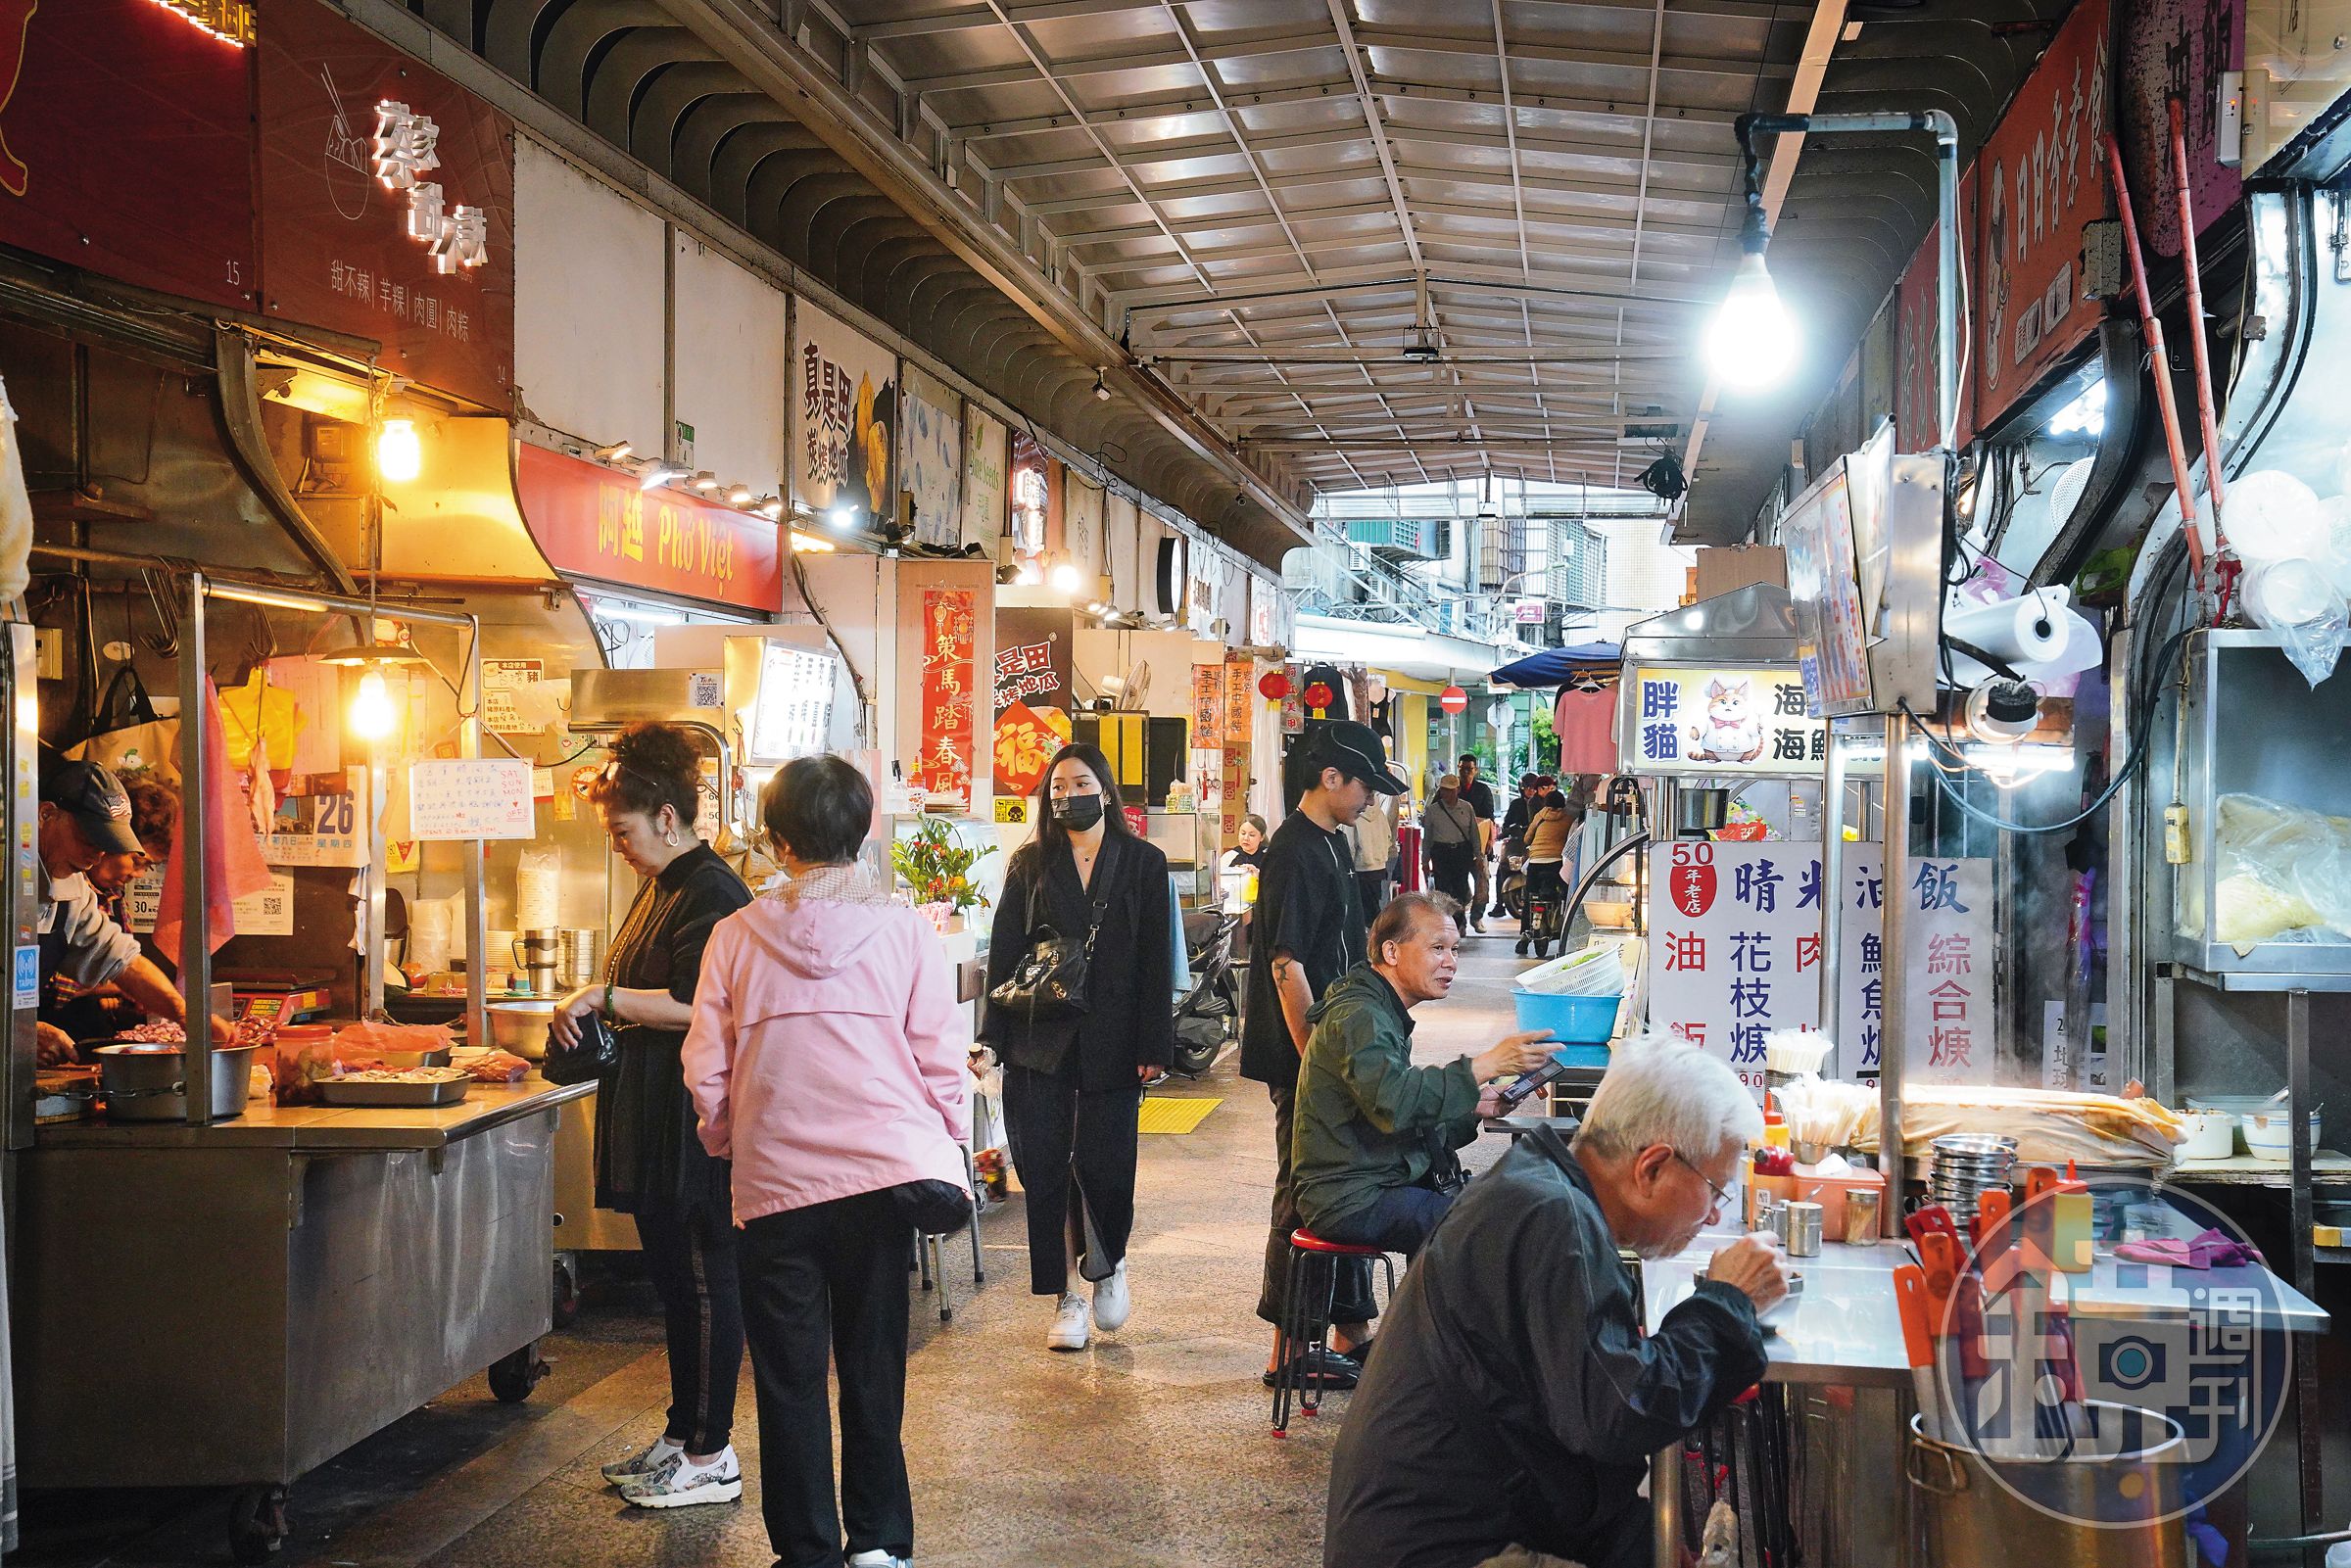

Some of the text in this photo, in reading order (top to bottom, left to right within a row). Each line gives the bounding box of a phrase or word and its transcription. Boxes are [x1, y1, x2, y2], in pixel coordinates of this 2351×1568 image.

[2016, 24, 2106, 263] 日日香素食
[226, 260, 240, 286] 15
[331, 260, 370, 305] 甜不辣
[379, 278, 406, 317] 芋粿
[413, 292, 437, 329] 肉圓
[497, 365, 506, 384] 14
[803, 339, 851, 437] 真是田
[807, 427, 848, 486] 炭烤地瓜
[933, 634, 960, 796] 策馬踏春風
[1643, 681, 1679, 761] 胖貓
[996, 722, 1043, 778] 福
[317, 789, 354, 834] 26
[1671, 843, 1713, 865] 50
[134, 901, 147, 913] 30
[1684, 869, 1703, 914] 年老店
